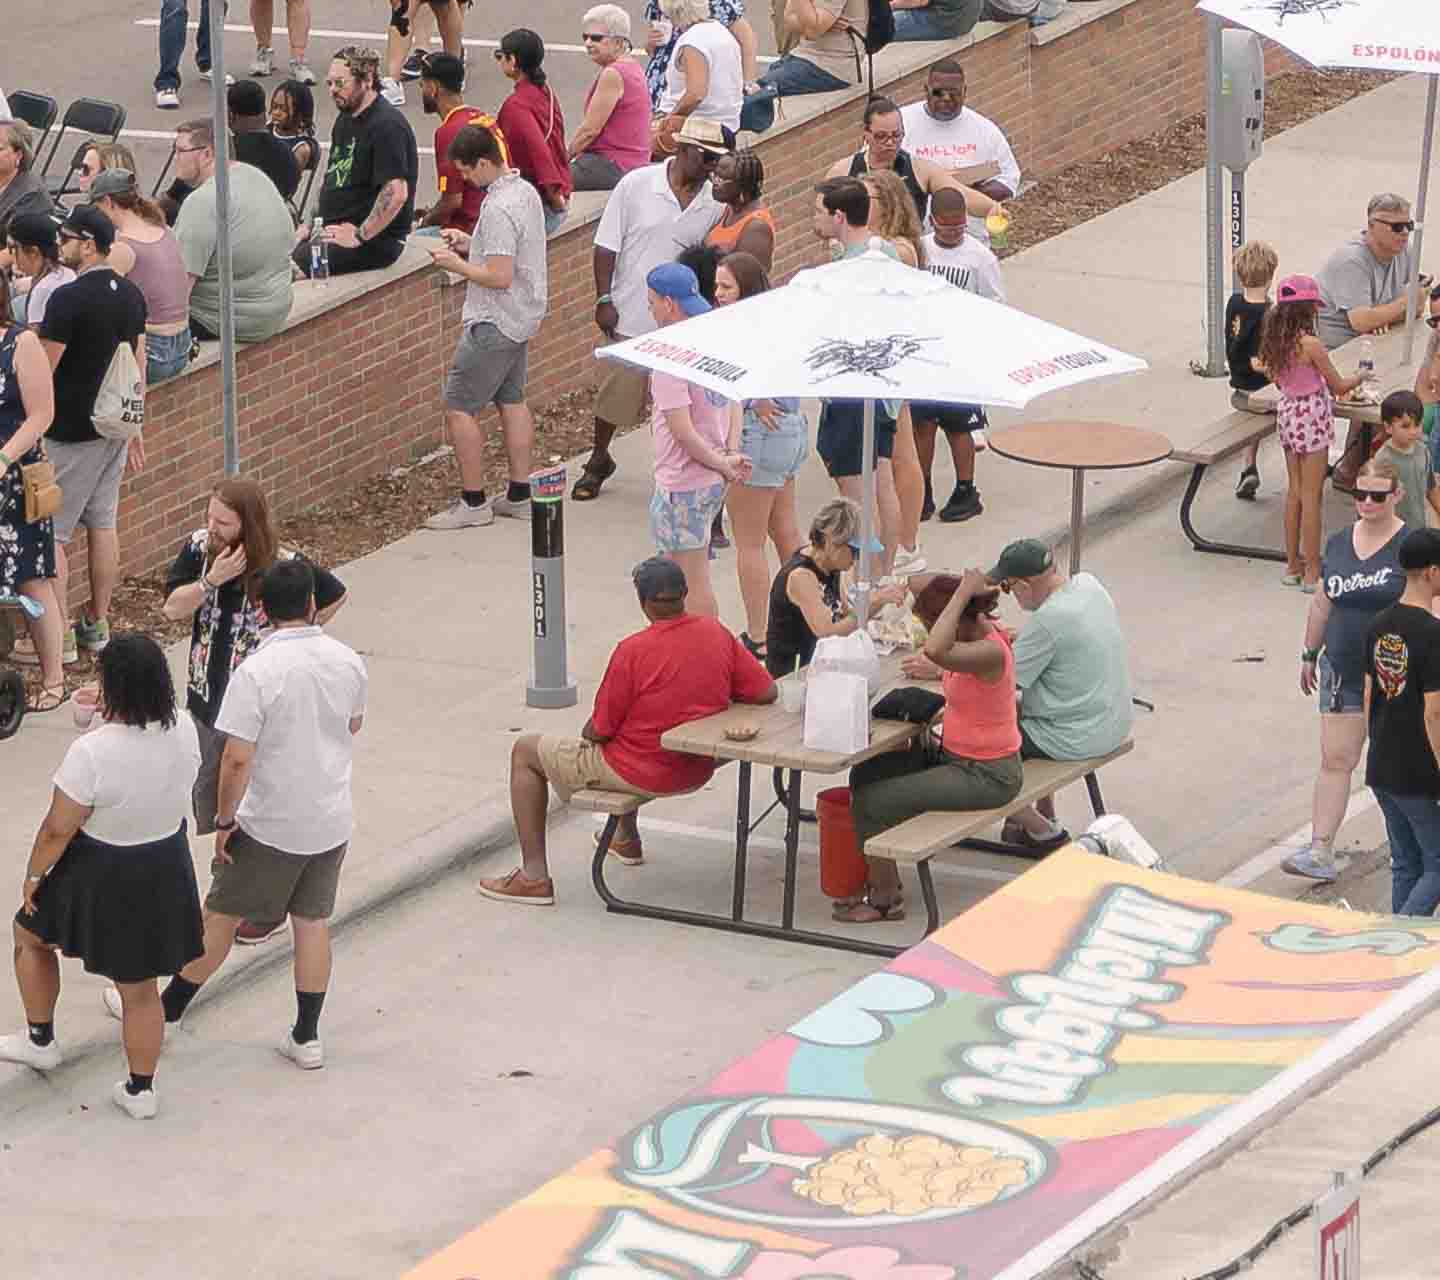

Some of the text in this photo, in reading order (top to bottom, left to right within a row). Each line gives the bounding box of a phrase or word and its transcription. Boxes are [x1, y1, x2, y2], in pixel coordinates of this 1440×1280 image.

[1352, 42, 1440, 63] ESPOLÓN
[1231, 191, 1241, 247] 1302
[697, 355, 750, 384] TEQUILA
[1058, 350, 1109, 373] TEQUILA
[1327, 566, 1393, 598] Detroit
[534, 573, 546, 639] 1301
